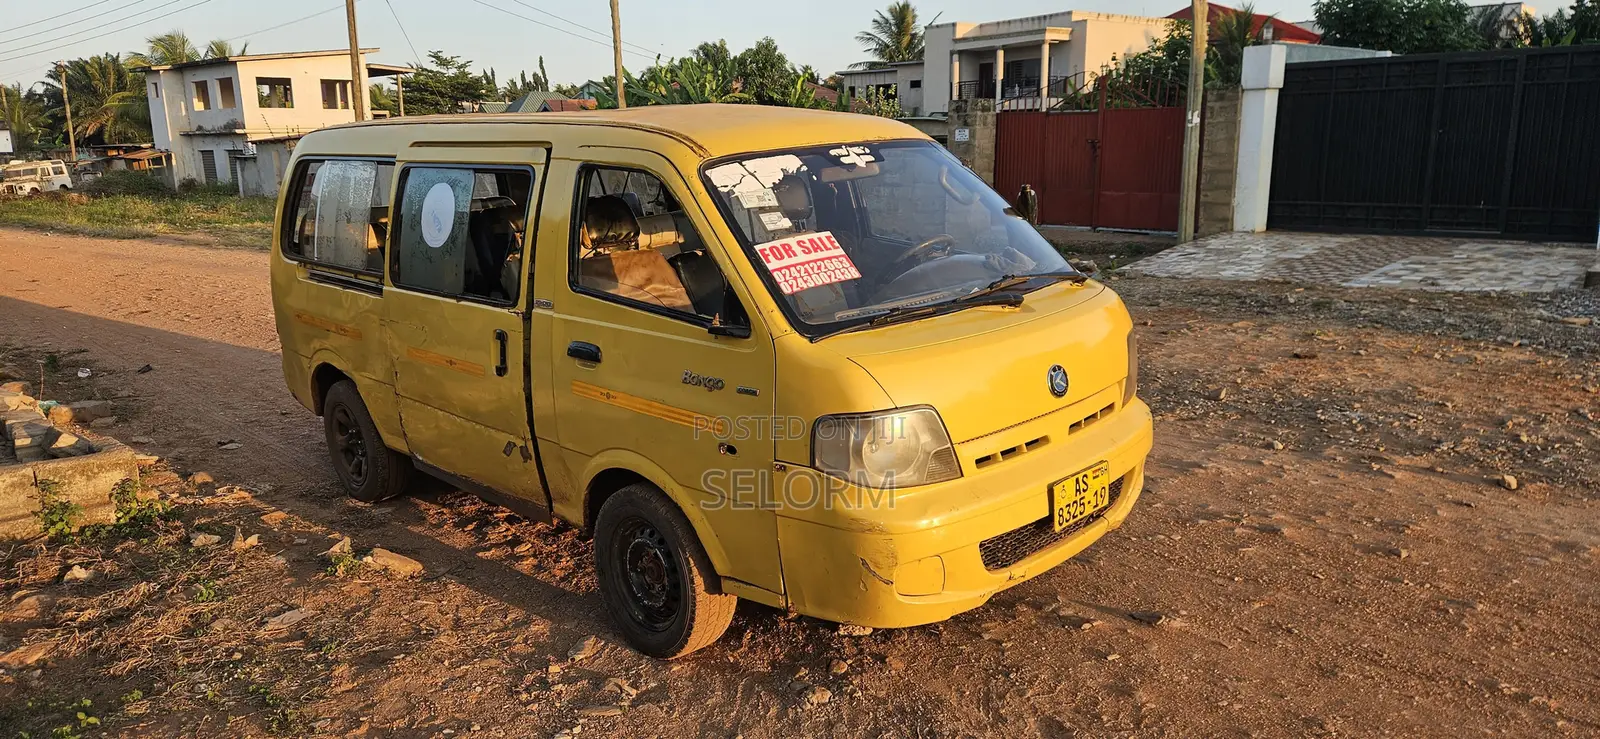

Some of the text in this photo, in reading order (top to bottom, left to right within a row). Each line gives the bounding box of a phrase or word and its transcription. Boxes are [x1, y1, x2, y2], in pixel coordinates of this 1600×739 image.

[758, 235, 840, 264] FOR SALE
[773, 257, 851, 282] 0242122663
[780, 267, 859, 294] 0243002438
[1075, 473, 1089, 497] AS
[1058, 486, 1106, 527] 8325-19
